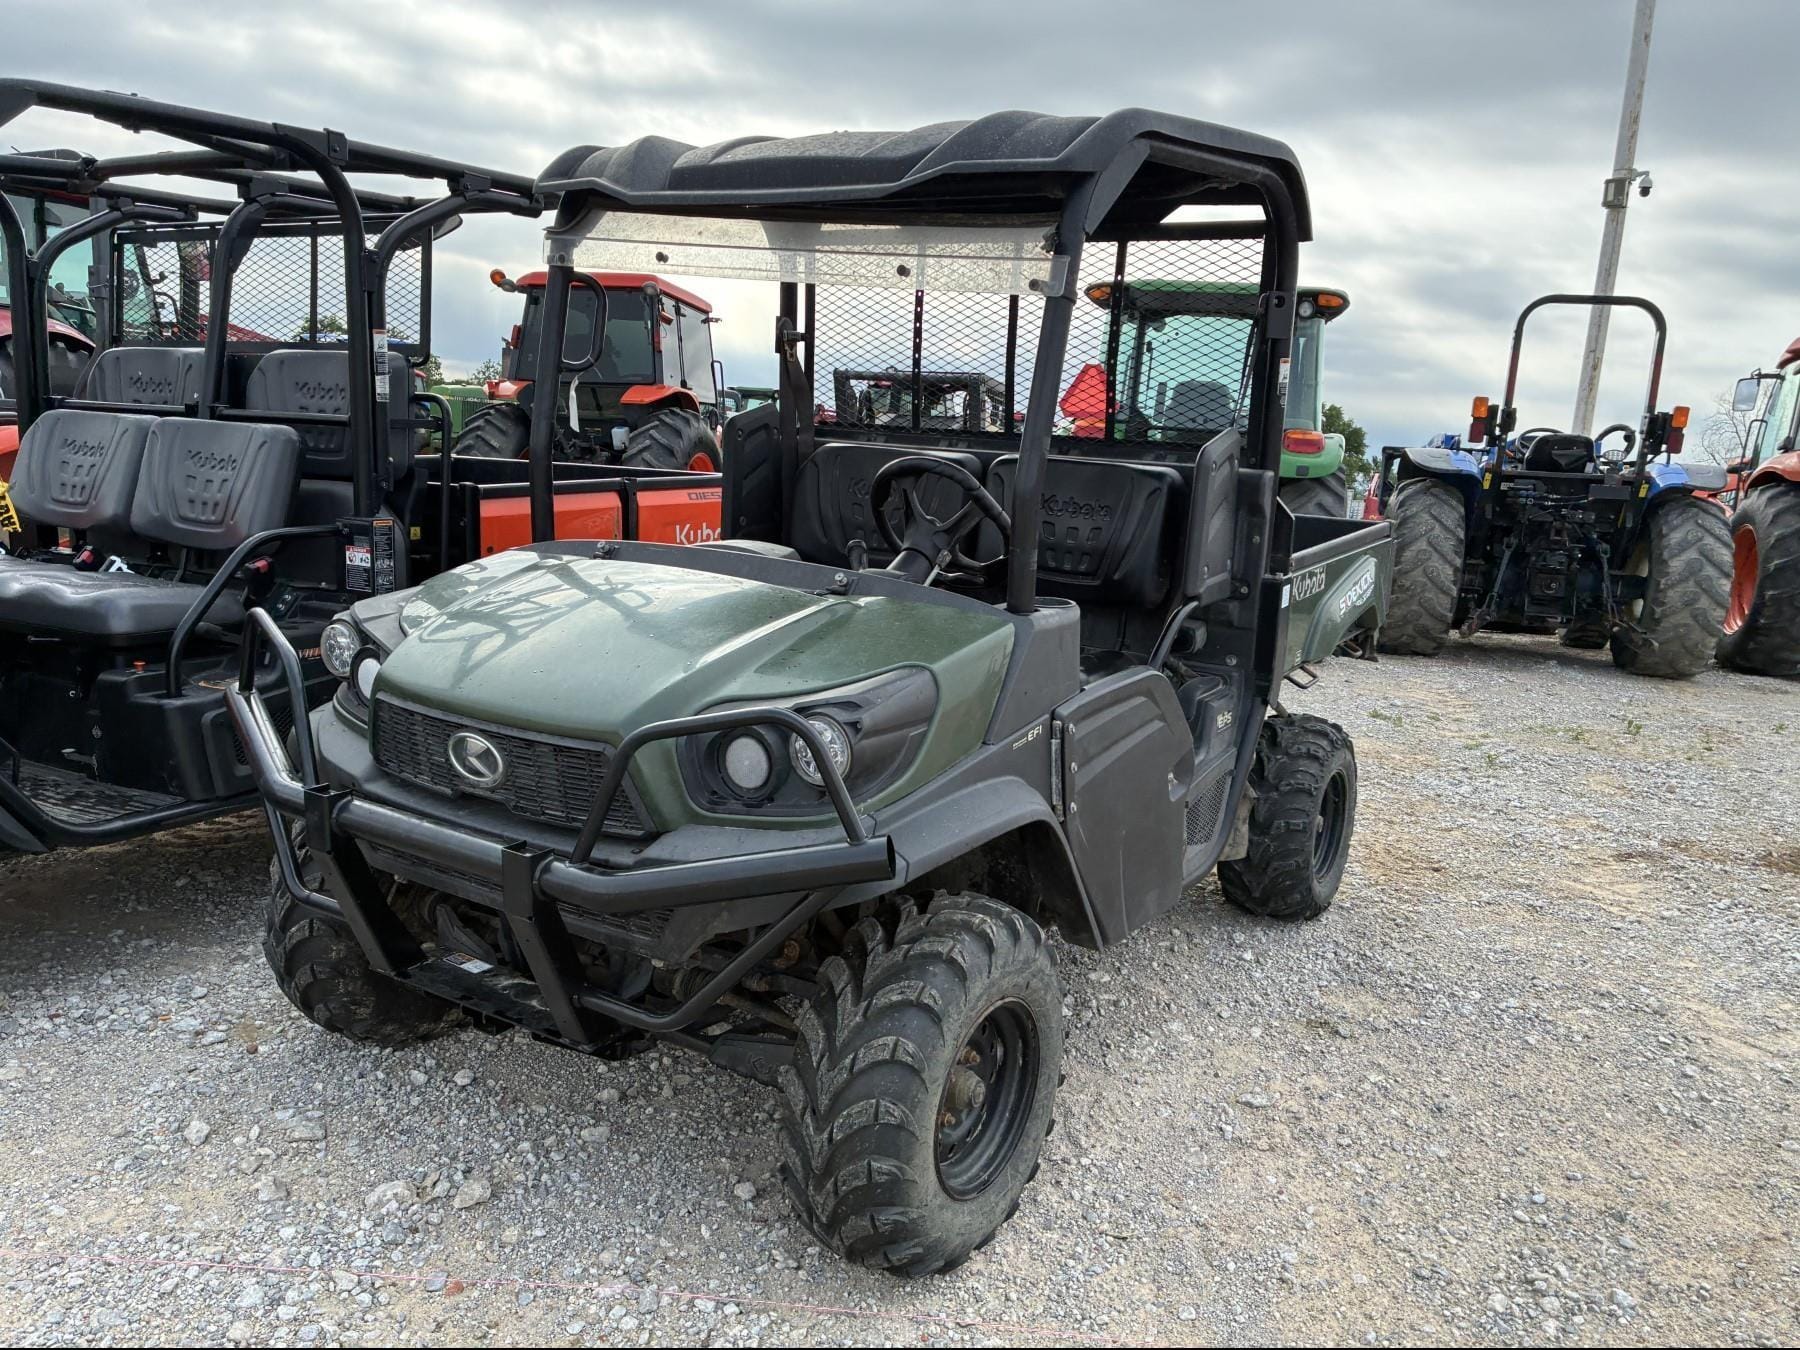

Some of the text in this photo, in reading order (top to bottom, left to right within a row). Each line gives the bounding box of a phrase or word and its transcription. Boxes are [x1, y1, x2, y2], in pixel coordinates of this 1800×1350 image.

[1040, 493, 1112, 521] Kubota
[1291, 564, 1326, 601] Kubota
[1339, 570, 1374, 617] SIDEKICK
[1027, 724, 1042, 741] EFI
